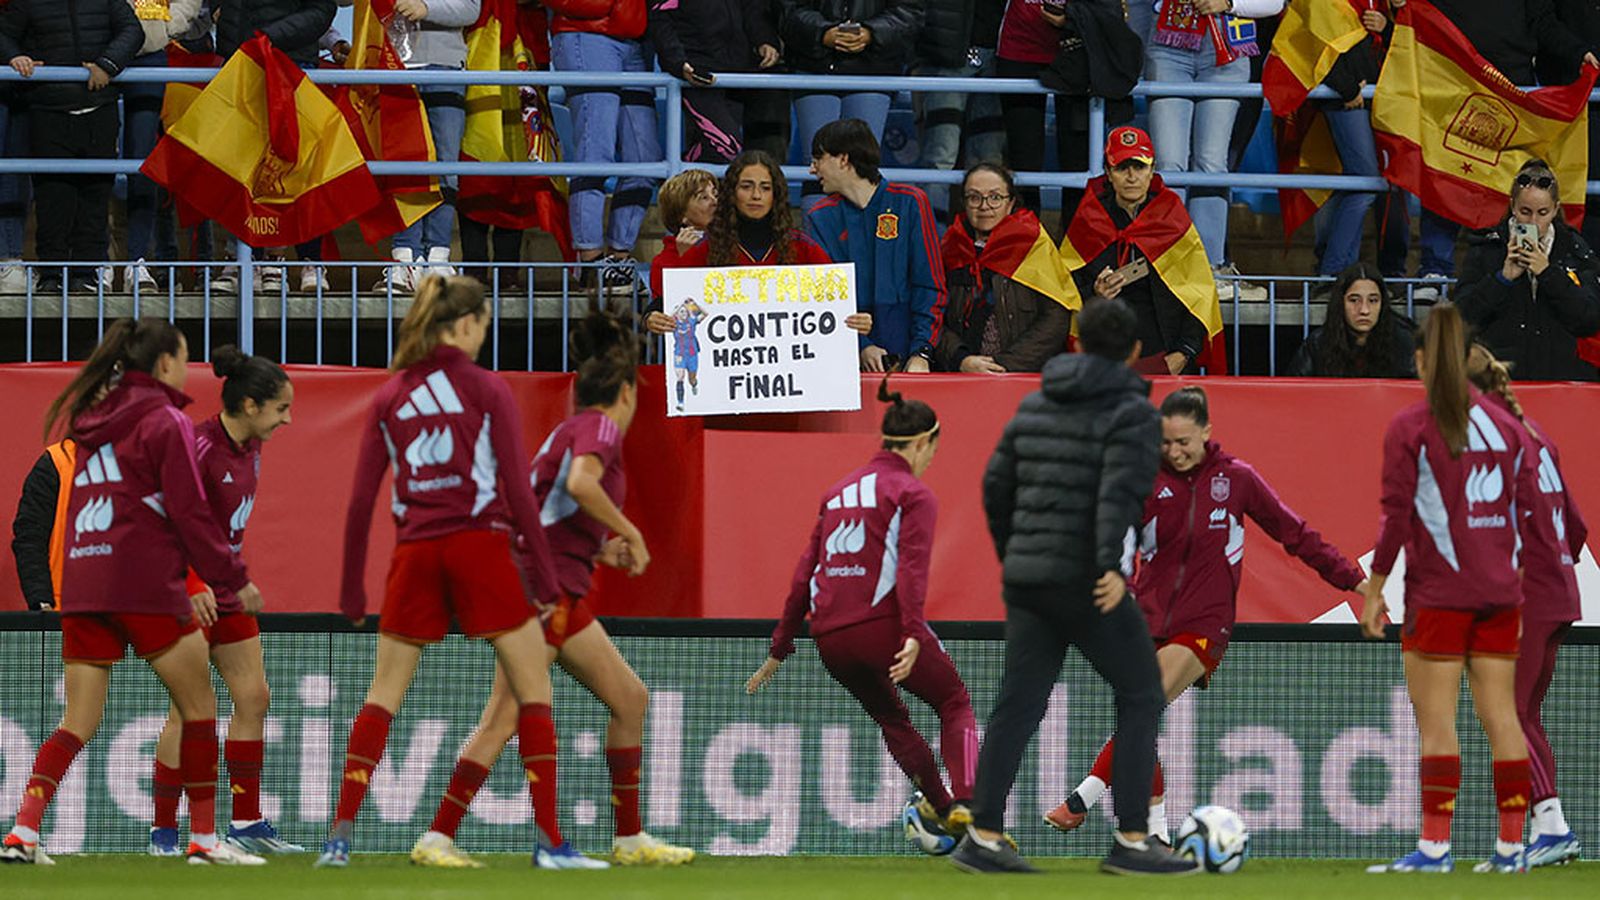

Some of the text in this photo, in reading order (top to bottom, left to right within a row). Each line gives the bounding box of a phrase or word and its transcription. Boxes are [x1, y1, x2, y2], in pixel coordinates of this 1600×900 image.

[703, 267, 849, 304] AITANA
[713, 343, 816, 367] HASTA EL
